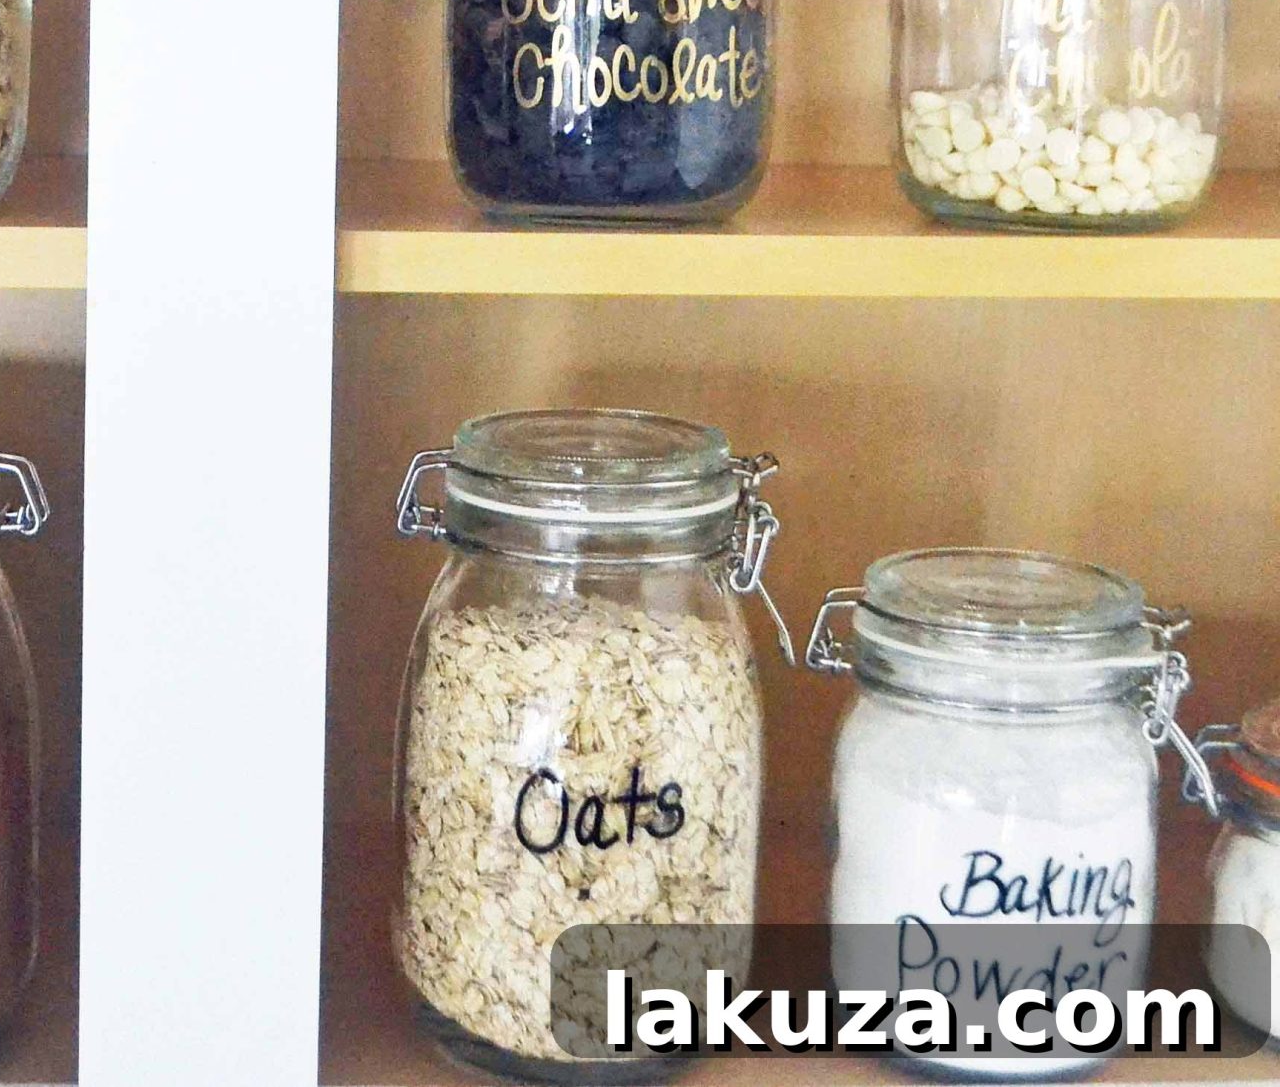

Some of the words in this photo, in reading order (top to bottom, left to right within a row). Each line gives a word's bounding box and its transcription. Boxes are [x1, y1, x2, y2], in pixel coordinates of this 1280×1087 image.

[514, 765, 687, 855] Oats
[939, 849, 1136, 948] Baking
[895, 913, 1128, 1010] Powder
